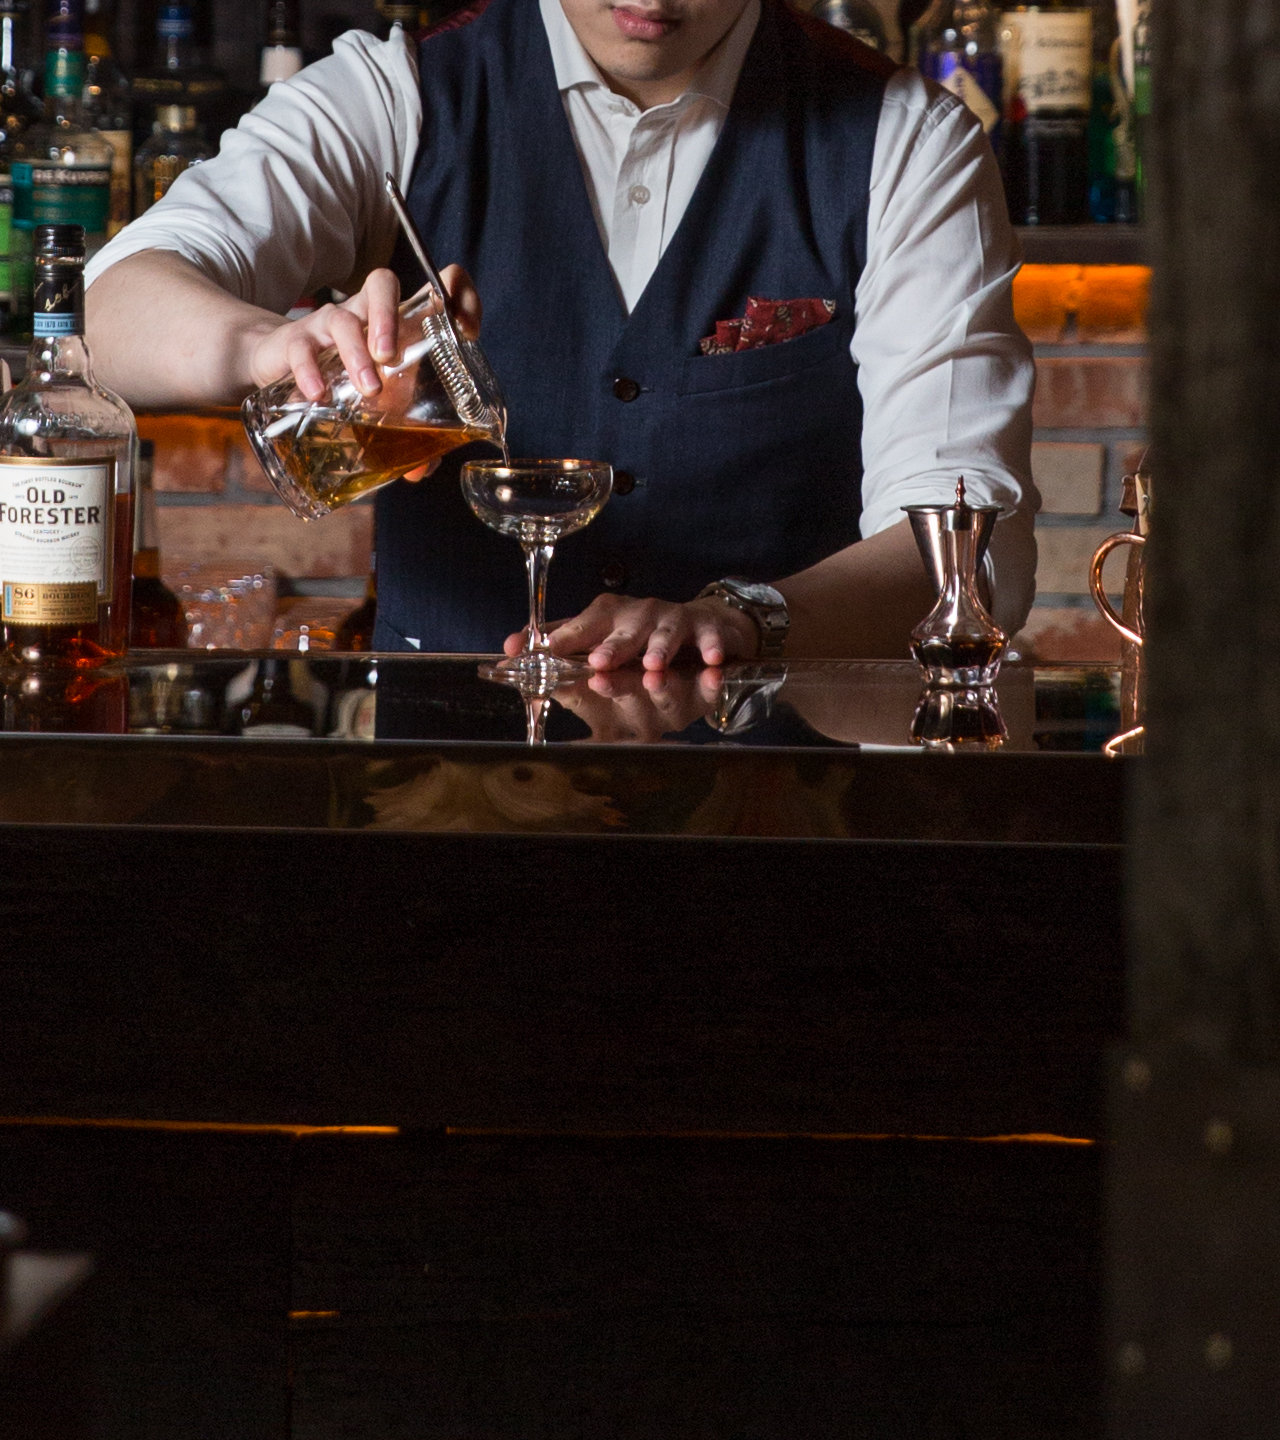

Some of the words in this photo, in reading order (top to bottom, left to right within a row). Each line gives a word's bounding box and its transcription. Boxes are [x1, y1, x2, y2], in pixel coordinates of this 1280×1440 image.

[26, 486, 66, 504] OLD
[0, 501, 100, 525] FORESTER
[13, 587, 35, 600] 86
